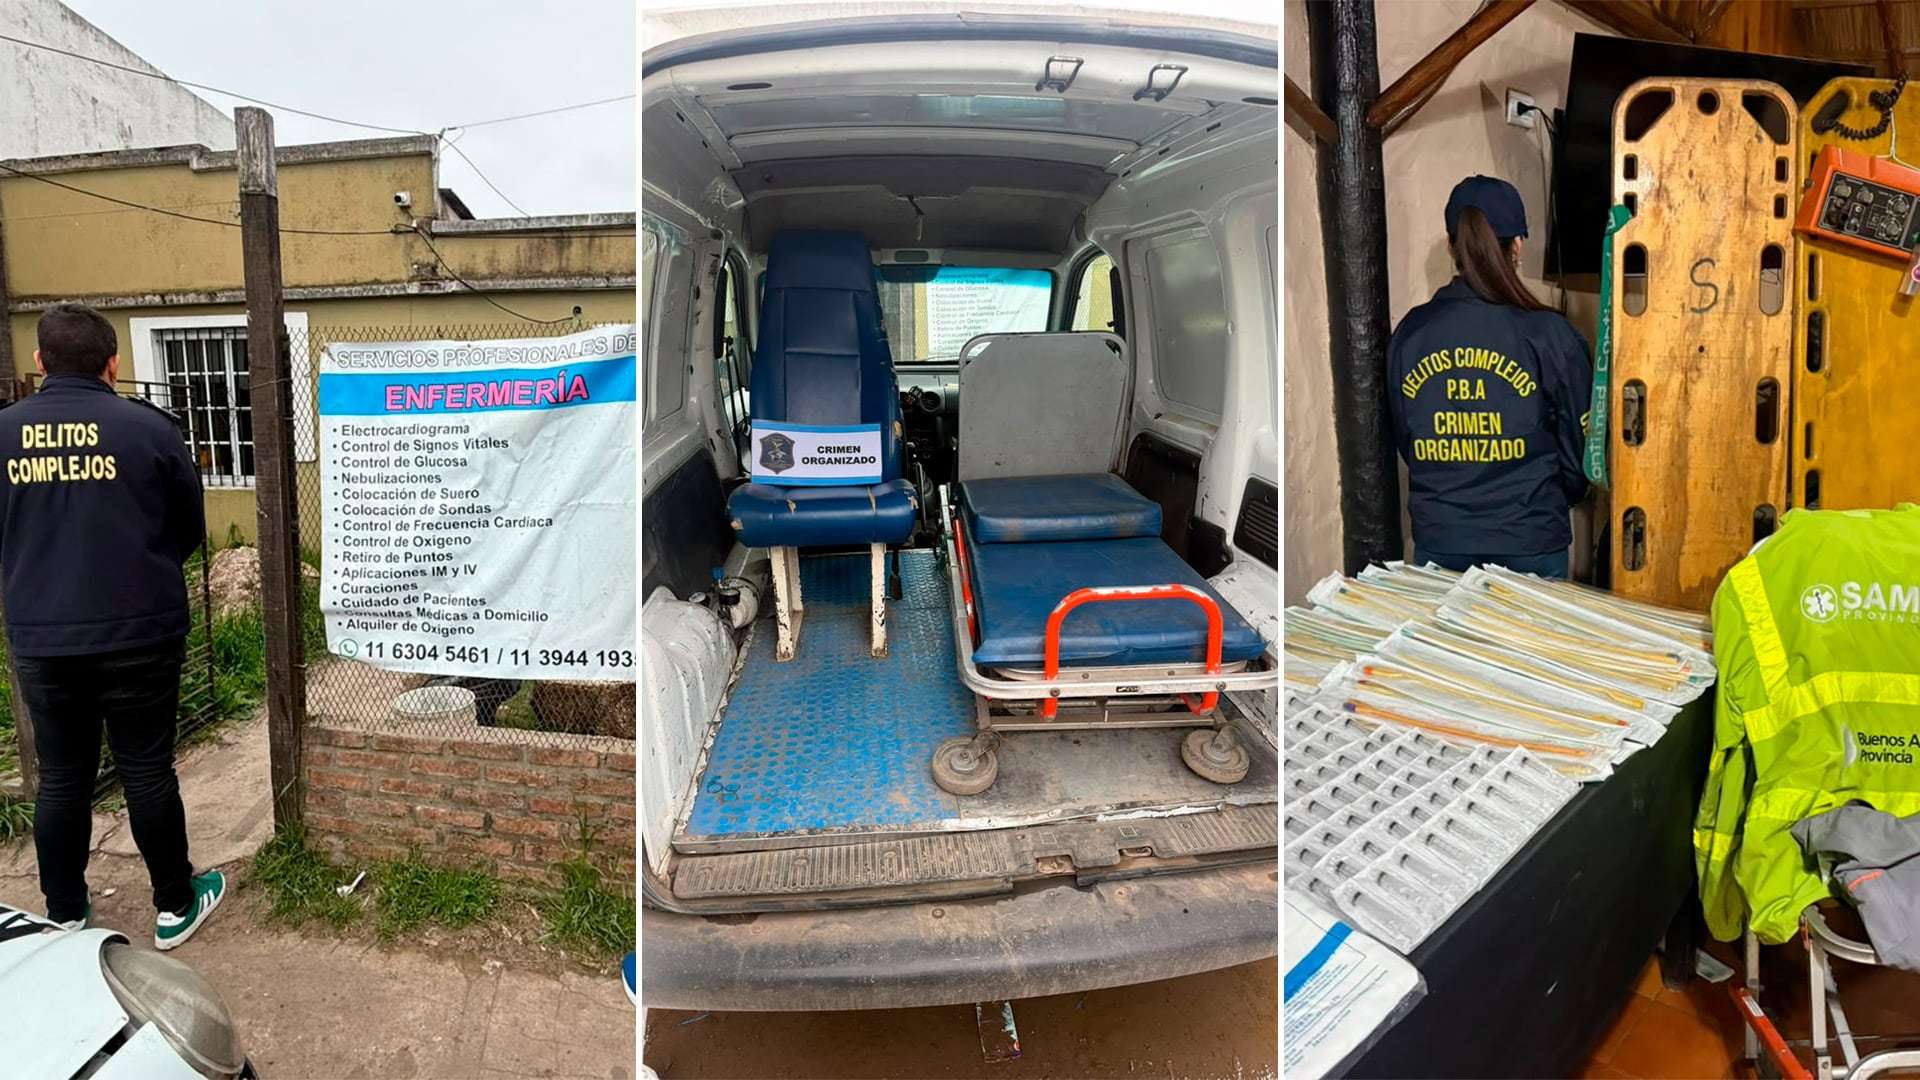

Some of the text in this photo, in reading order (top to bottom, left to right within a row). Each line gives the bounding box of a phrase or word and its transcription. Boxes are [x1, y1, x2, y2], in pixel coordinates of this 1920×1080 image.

[1690, 257, 1718, 313] S
[337, 334, 636, 368] SERVICIOS PROFESIONALES DE
[1402, 347, 1537, 399] DELITOS COMPLEJOS
[385, 369, 589, 411] ENFERMERÍA
[1446, 379, 1486, 400] P.B.A
[341, 424, 470, 437] Electrocardiograma
[1434, 411, 1502, 435] CRIMEN
[22, 423, 98, 449] DELITOS
[1588, 386, 1607, 482] ontimed
[341, 437, 509, 454] Control de Signos Vitales
[1414, 438, 1525, 462] ORGANIZADO
[341, 455, 468, 468] Control de Glucosa
[801, 445, 876, 465] CRIMEN ORGANIZADO
[7, 455, 116, 485] COMPLEJOS
[341, 471, 442, 484] Nebulizaciones
[342, 487, 480, 500] Colocación de Suero
[342, 503, 492, 516] Colocación de Sondas
[343, 519, 391, 532] Control
[395, 520, 410, 531] de
[414, 518, 490, 531] Frecuencia
[342, 535, 391, 547] Control
[394, 536, 409, 547] de
[342, 551, 454, 563] Retiro de Puntos
[341, 564, 477, 580] Aplicaciones IM y IV
[341, 582, 418, 594] Curaciones
[341, 592, 487, 609] Cuidado de Pacientes
[473, 611, 480, 620] a
[484, 609, 549, 622] Domicilio
[346, 619, 398, 632] Alquiler
[402, 621, 417, 631] de
[365, 641, 384, 658] 11
[392, 643, 439, 660] 6304
[445, 646, 489, 663] 5461
[510, 649, 529, 665] 11
[539, 650, 589, 666] 3944
[595, 650, 636, 667] 193
[1857, 732, 1905, 747] Buenos
